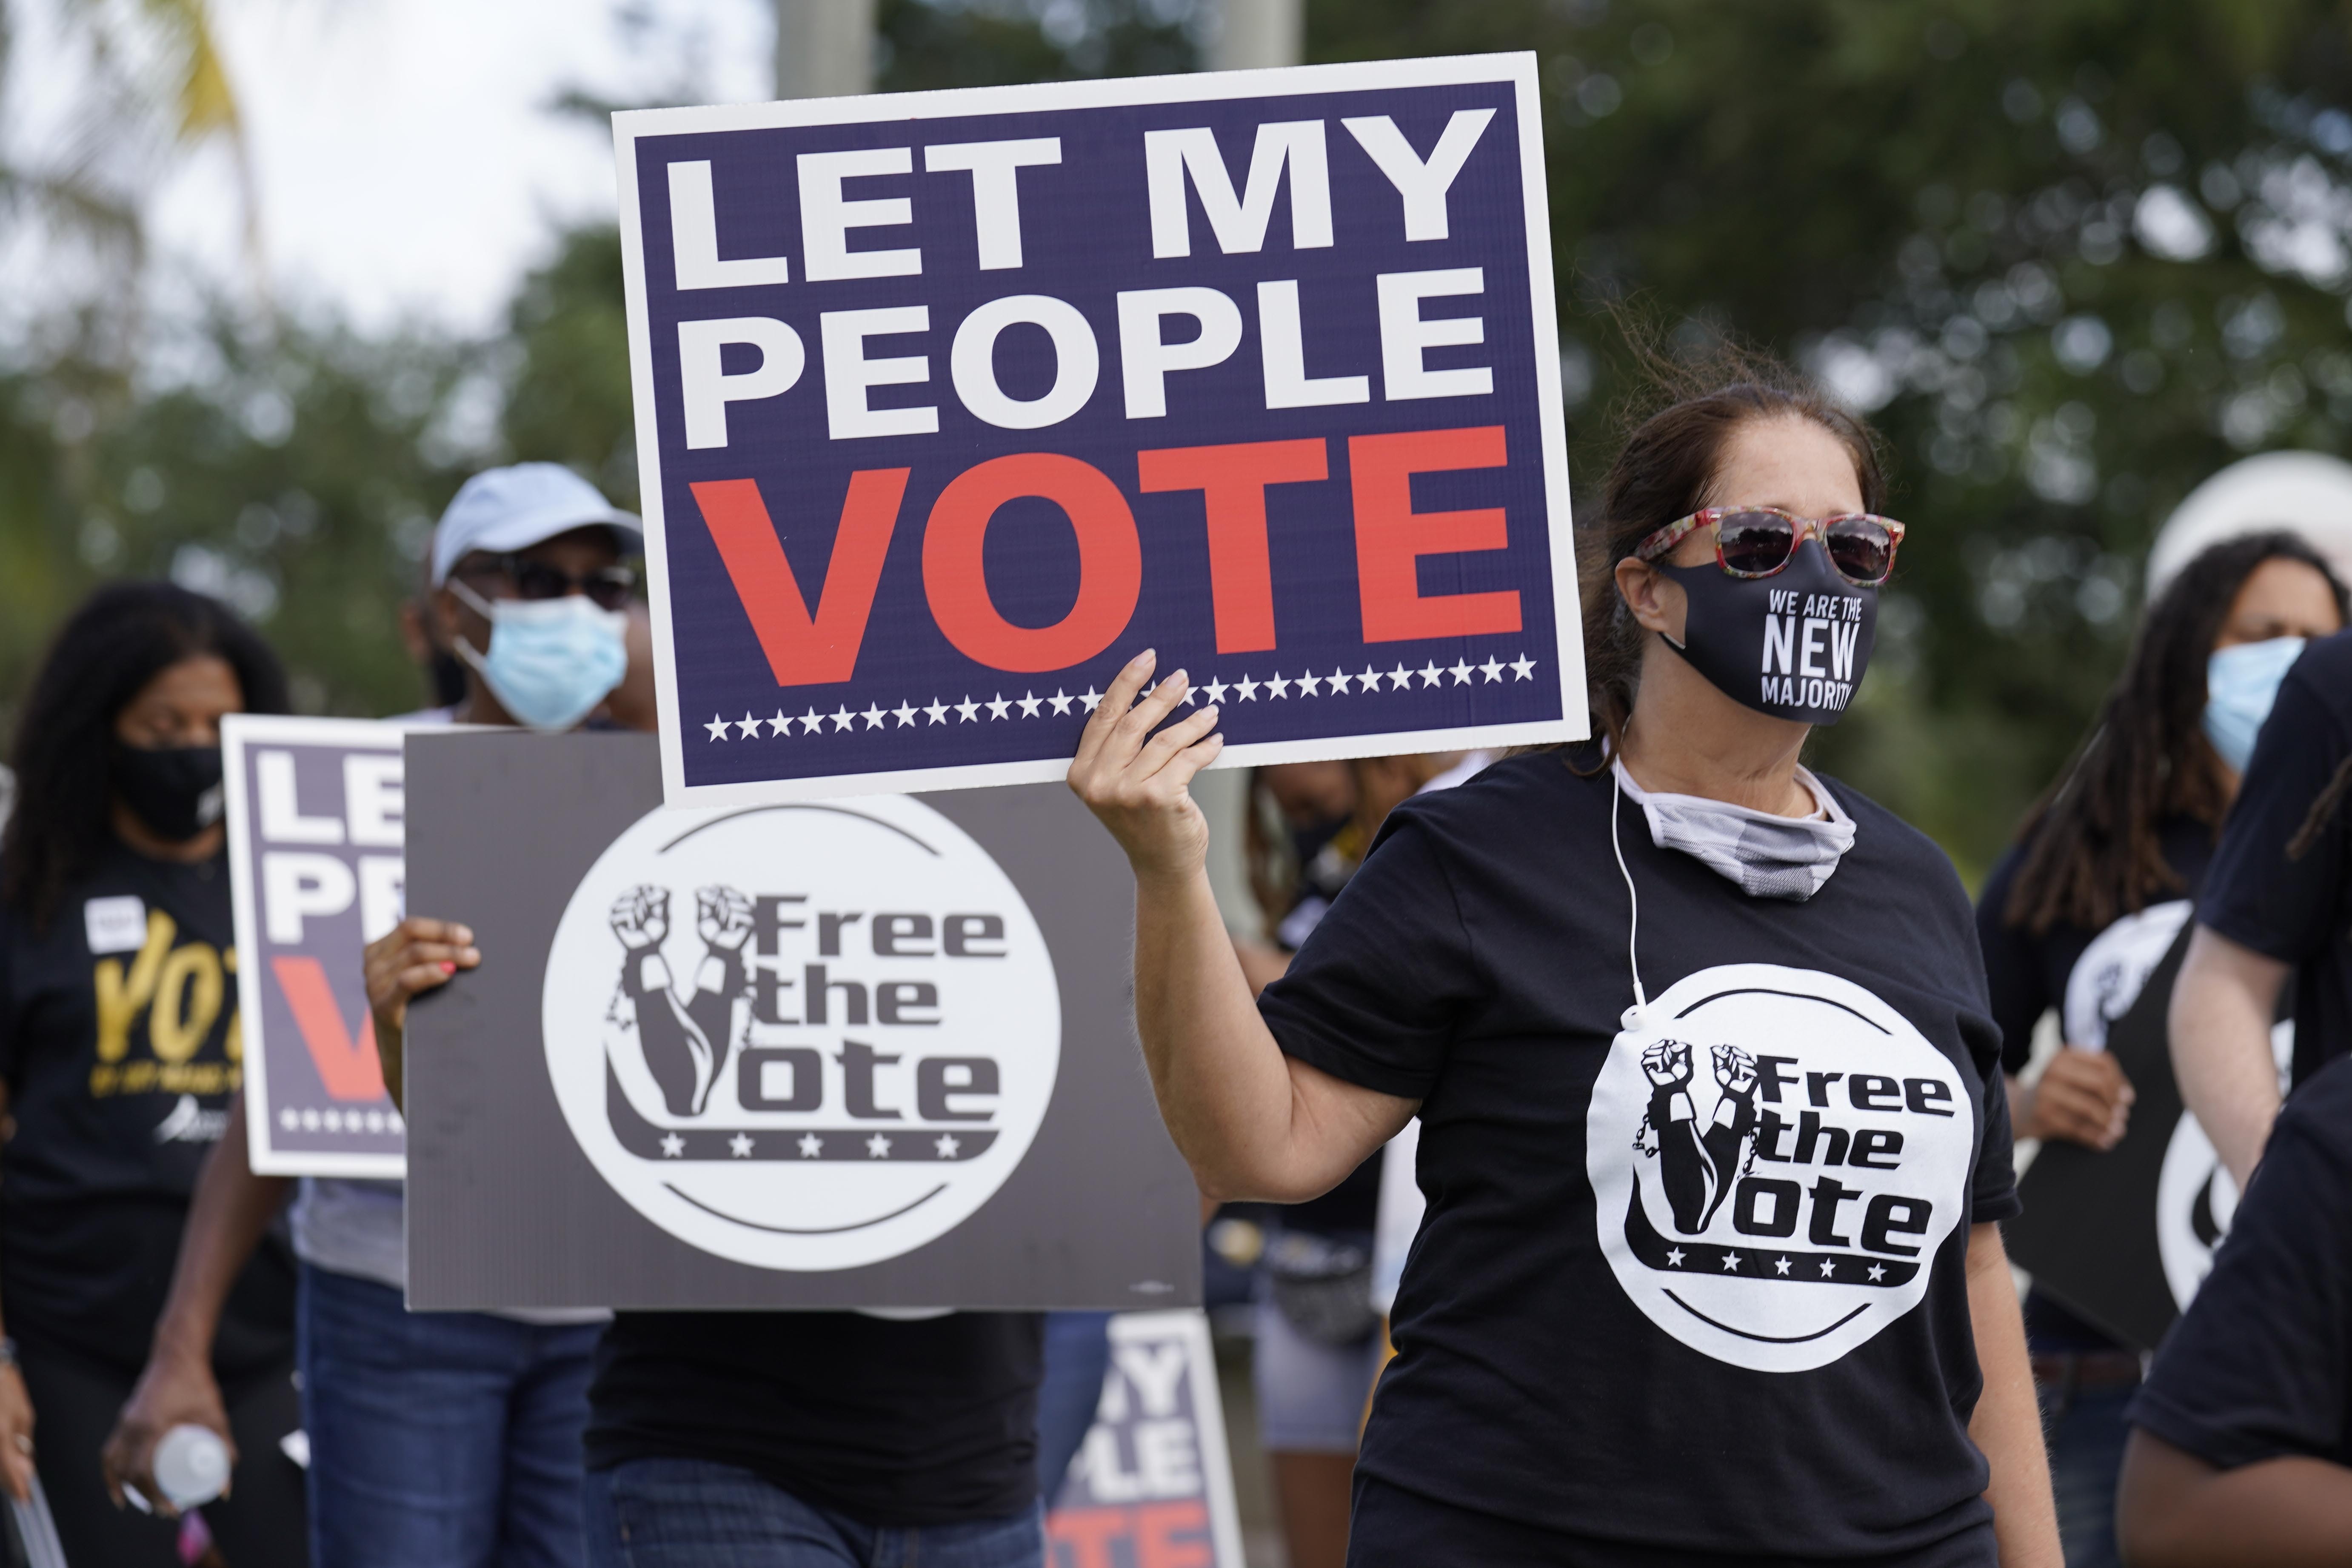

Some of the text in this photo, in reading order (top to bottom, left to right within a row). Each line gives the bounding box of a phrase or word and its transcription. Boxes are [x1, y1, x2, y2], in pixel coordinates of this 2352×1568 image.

[666, 107, 1497, 291] LET MY
[677, 266, 1494, 450] PEOPLE
[688, 425, 1523, 687] VOTE
[1769, 588, 1863, 622] WE ARE THE
[1761, 614, 1861, 682] NEW
[1761, 676, 1853, 711] MAJORITY
[755, 894, 1008, 958] Free
[754, 963, 943, 1026] the
[1753, 1054, 1956, 1118] Free
[1755, 1109, 1905, 1170] the
